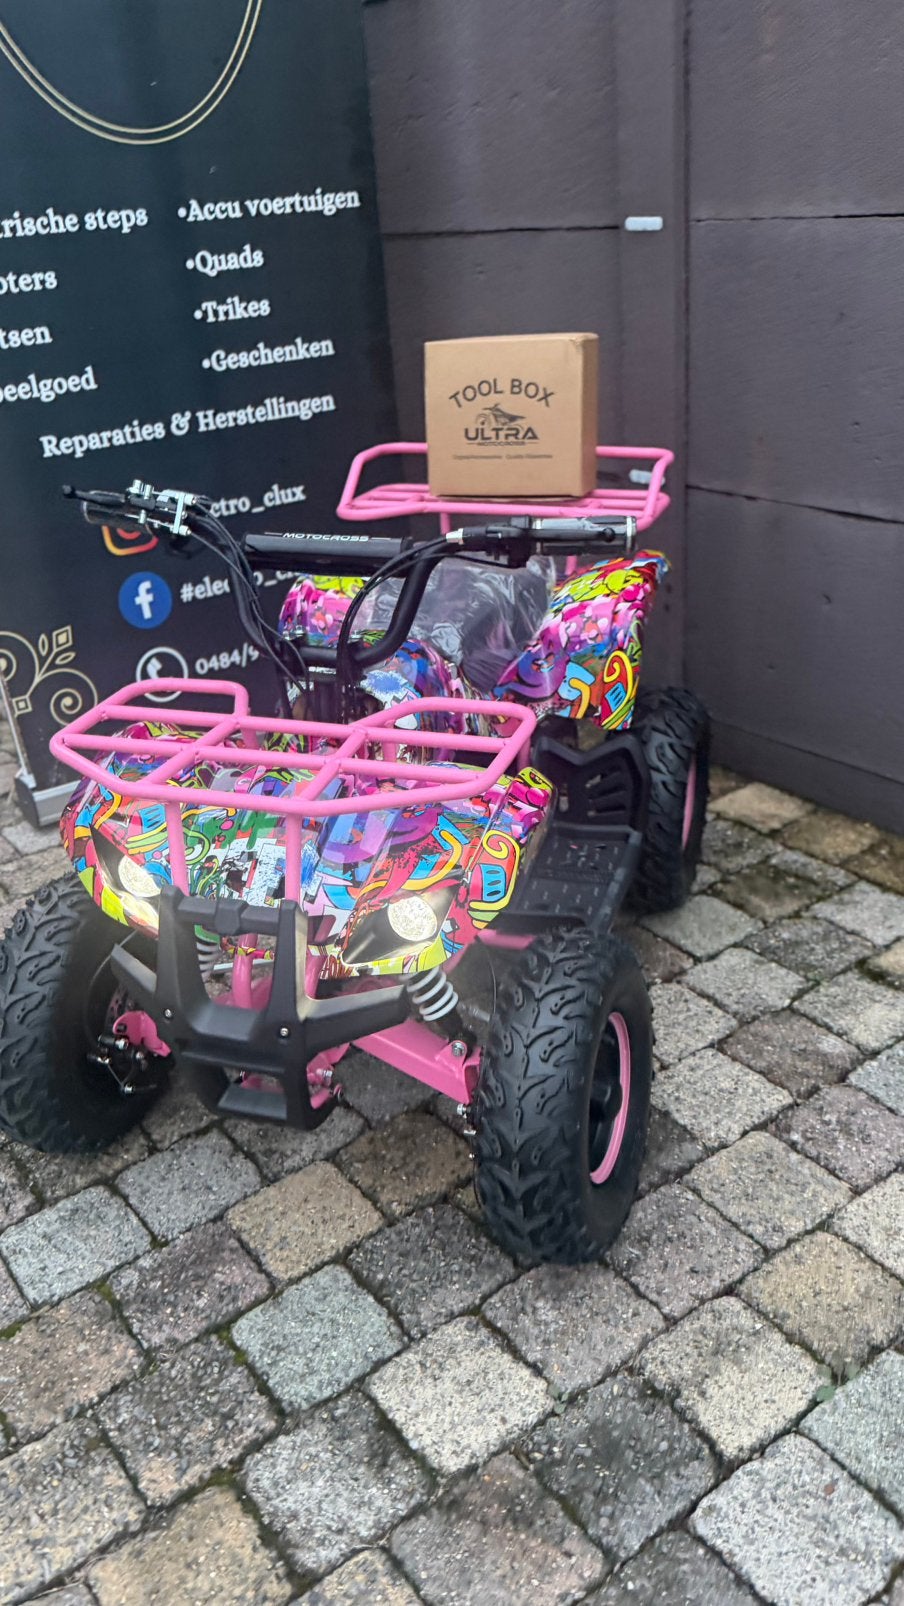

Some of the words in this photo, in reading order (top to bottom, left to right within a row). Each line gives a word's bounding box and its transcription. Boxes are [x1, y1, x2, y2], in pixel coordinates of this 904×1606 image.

[246, 187, 361, 217] voertuigen
[85, 207, 148, 233] steps
[0, 365, 98, 403] eelgoed
[448, 378, 504, 408] TOOL
[510, 378, 555, 407] BOX
[40, 420, 166, 458] Reparaties
[171, 411, 191, 435] &
[196, 394, 336, 432] Herstellingen
[464, 427, 539, 441] ULTRA
[282, 532, 370, 542] MOTOCROSS
